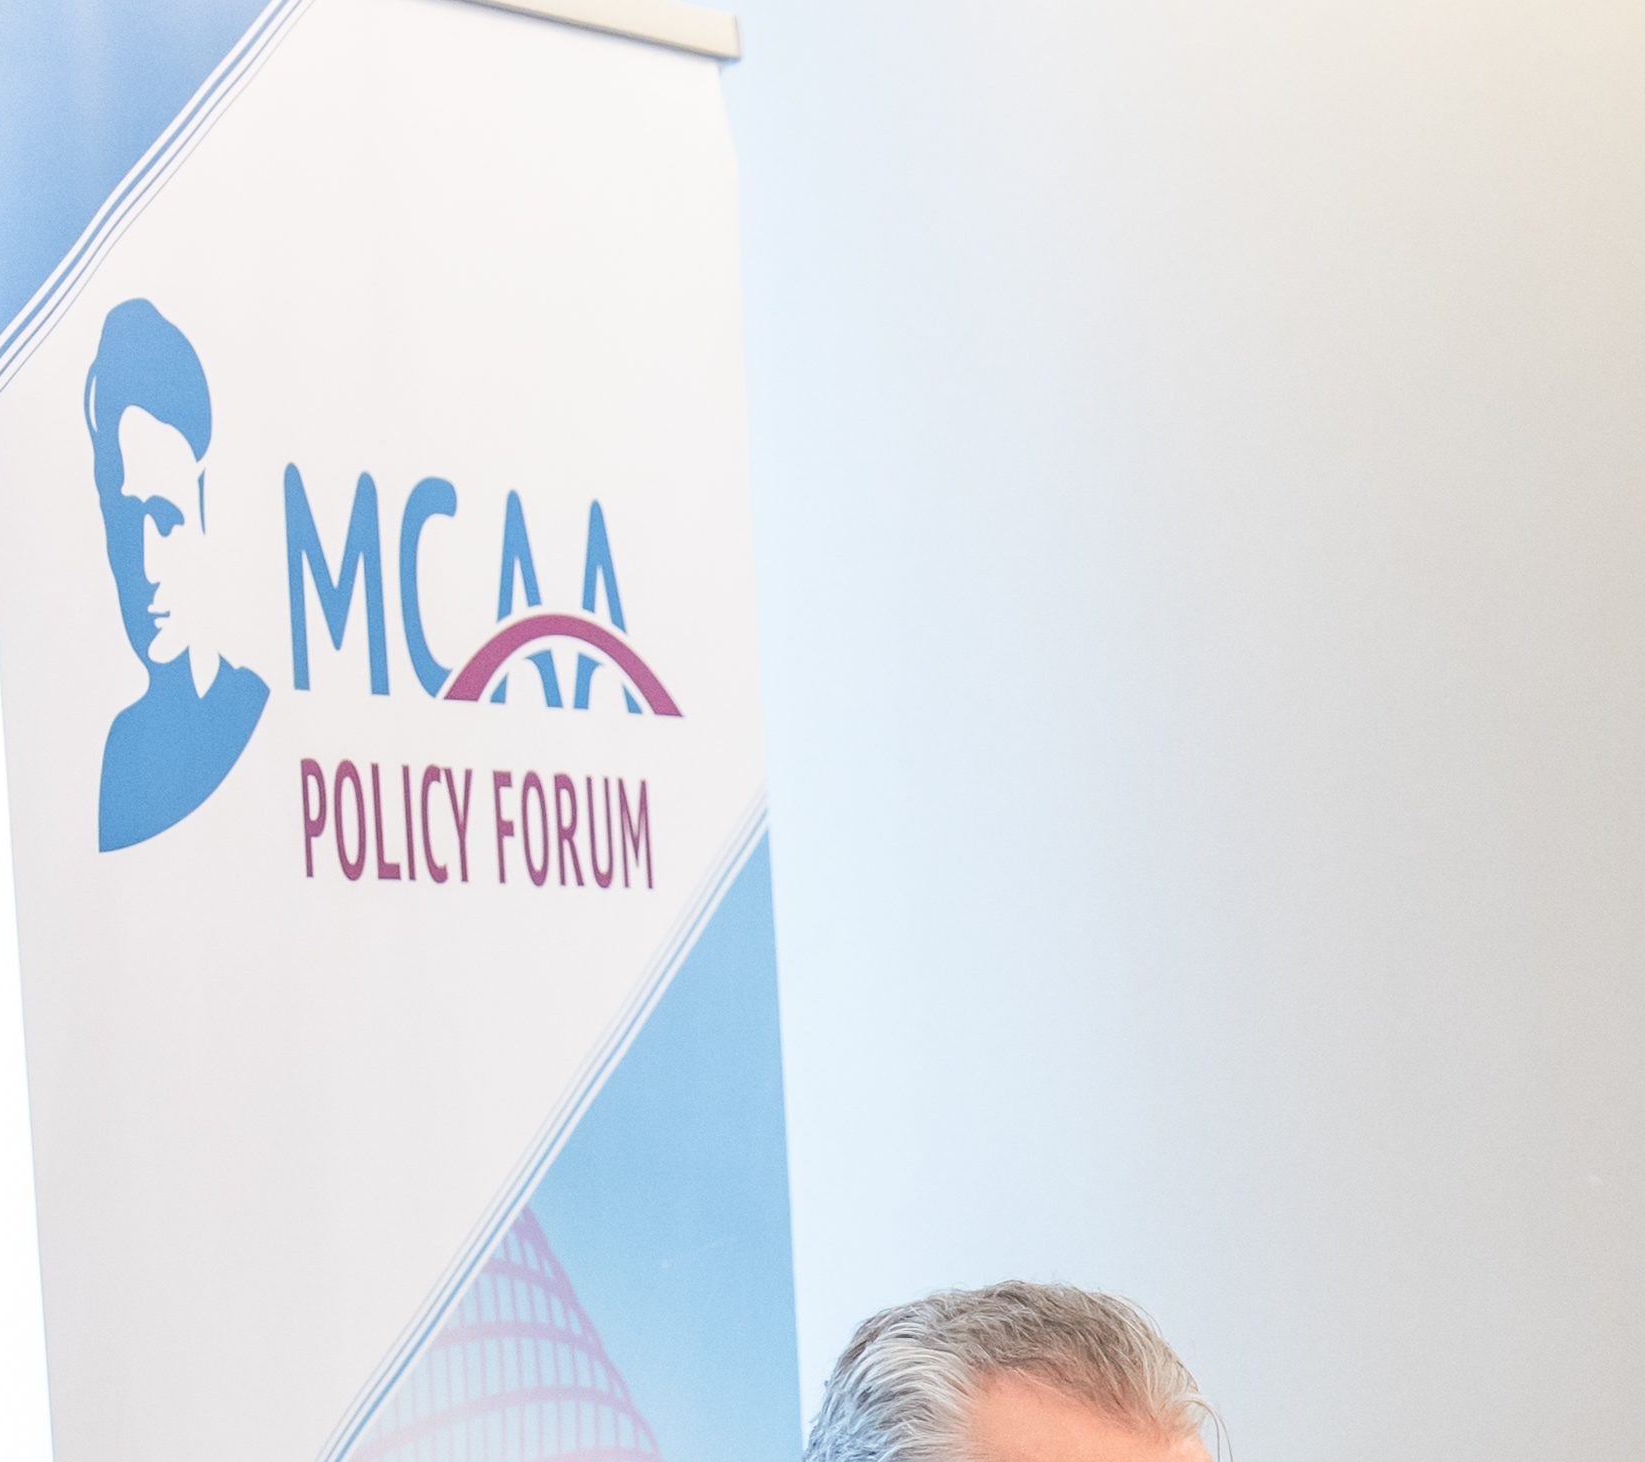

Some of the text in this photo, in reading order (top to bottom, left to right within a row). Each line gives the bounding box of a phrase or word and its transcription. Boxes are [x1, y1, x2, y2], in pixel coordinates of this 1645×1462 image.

[284, 462, 647, 716] MCAA
[300, 758, 654, 890] POLICY FORUM
